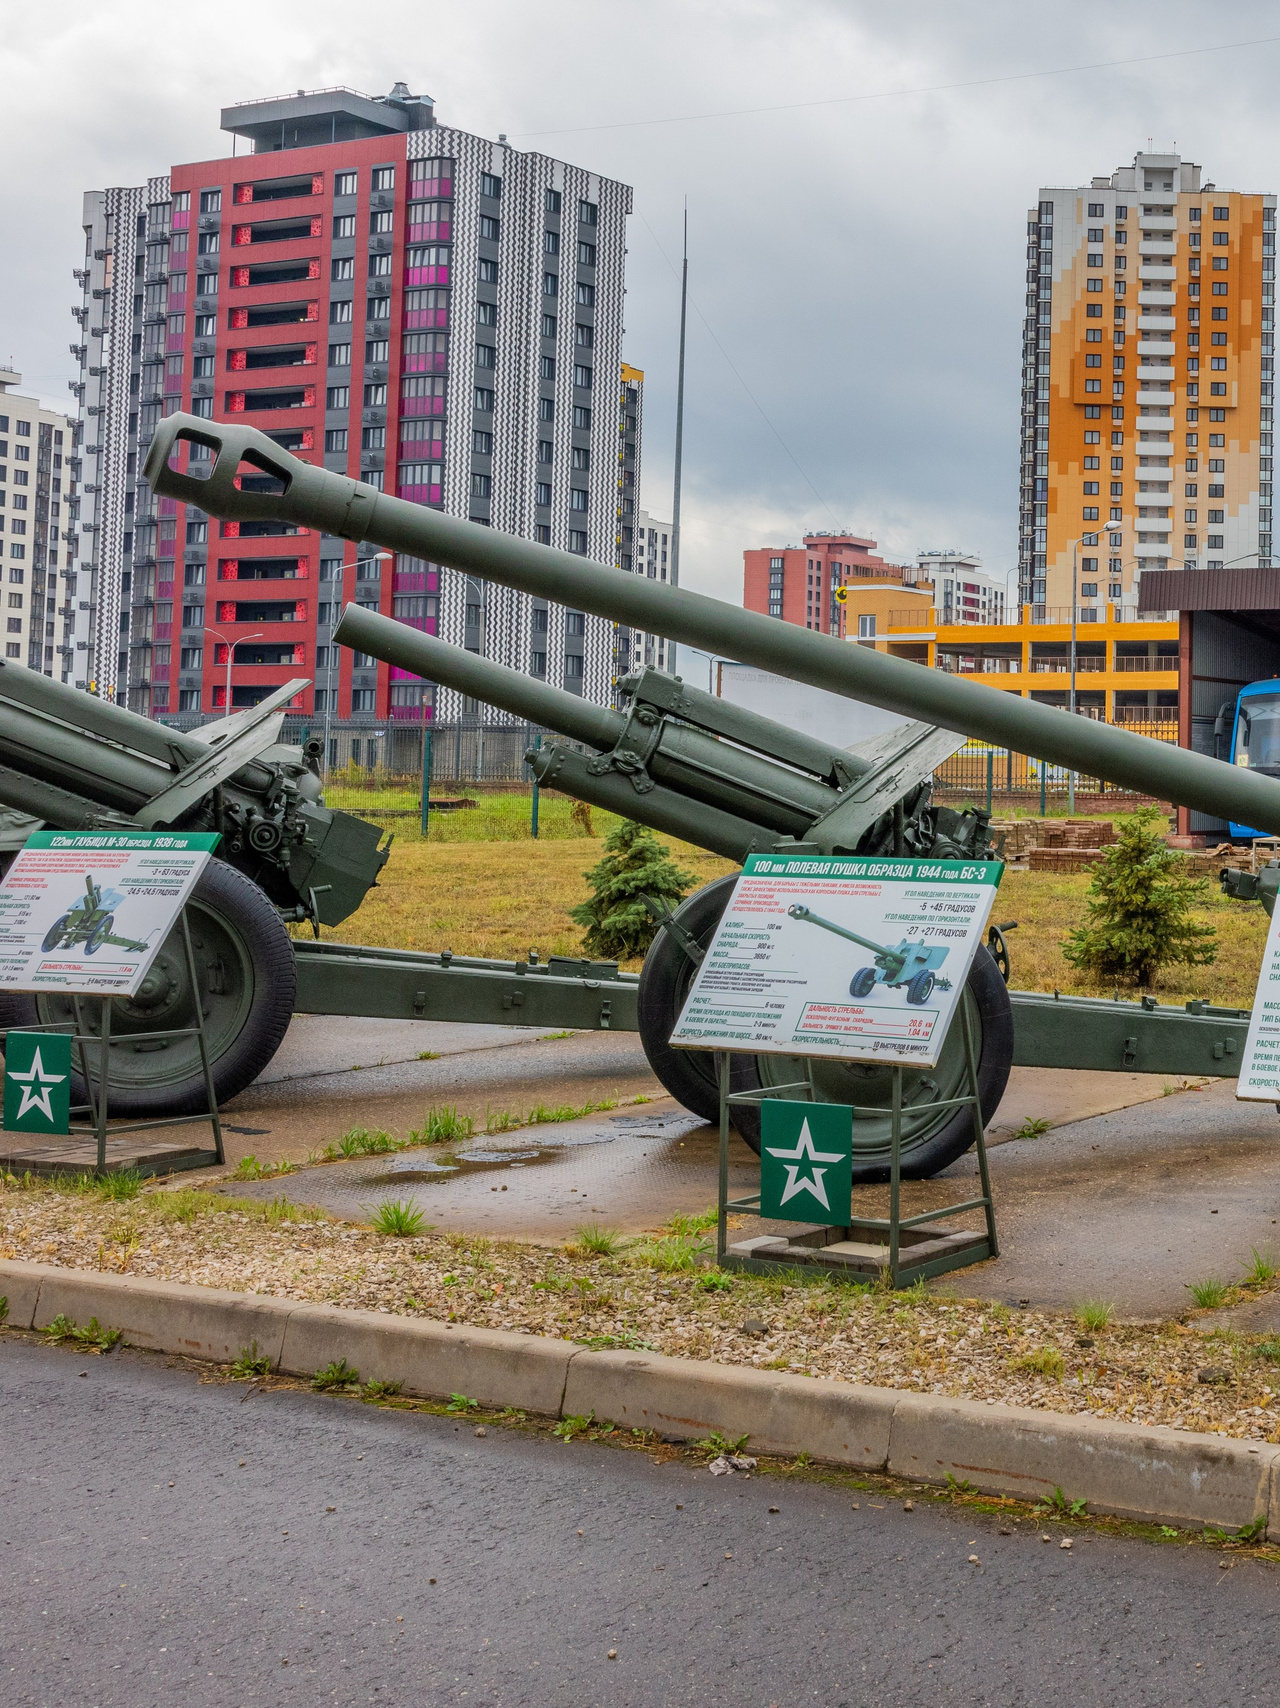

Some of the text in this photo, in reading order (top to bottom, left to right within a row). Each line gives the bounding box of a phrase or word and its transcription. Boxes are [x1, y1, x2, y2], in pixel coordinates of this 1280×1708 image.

[752, 860, 772, 872] 100
[784, 861, 831, 874] ПОЛЕВАЯ
[829, 862, 868, 875] ПУШКА
[866, 863, 915, 878] ОБРАЗЦА
[914, 865, 942, 878] 1944
[940, 870, 959, 879] ГОДА
[959, 866, 987, 879] БС-3
[918, 902, 976, 913] -5 +45 ГРАДУСОВ
[897, 913, 928, 921] НАВЕДЕНИЯ
[905, 926, 968, 937] -27 +27 ГРАДУСОВ
[808, 1004, 865, 1014] ДАЛЬНОСТЬ СТРЕЛЬБЫ:
[1260, 1014, 1274, 1022] ТИП
[1253, 1053, 1273, 1061] ВРЕМЯ
[1256, 1063, 1278, 1071] БОЕВОЕ
[1247, 1077, 1280, 1087] СКОРОСТЬ
